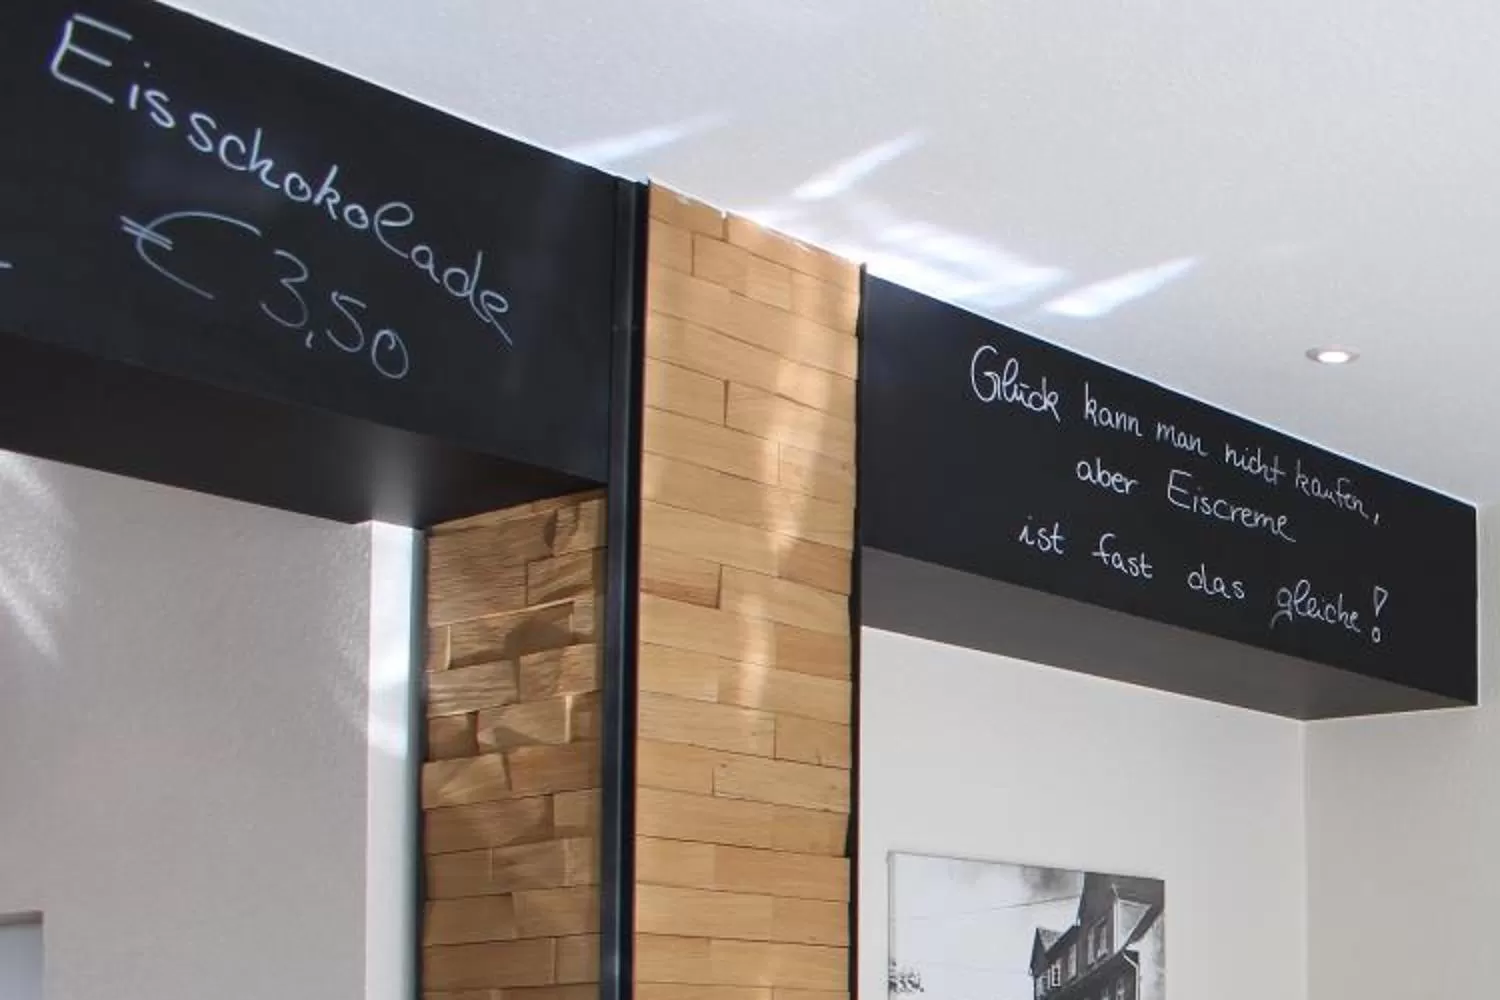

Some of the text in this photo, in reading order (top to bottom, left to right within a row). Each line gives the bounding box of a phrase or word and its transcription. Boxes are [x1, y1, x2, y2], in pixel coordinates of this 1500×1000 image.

[50, 14, 513, 347] Eisschokolade
[259, 249, 409, 379] 3,50
[970, 345, 1060, 422] Glück
[1084, 381, 1143, 438] kann
[1156, 421, 1208, 458] man
[1225, 442, 1287, 486] nicht
[1018, 515, 1065, 556] ist
[1091, 533, 1153, 580] fast
[1187, 564, 1245, 600] das
[1076, 457, 1297, 543] aber Eiscreme
